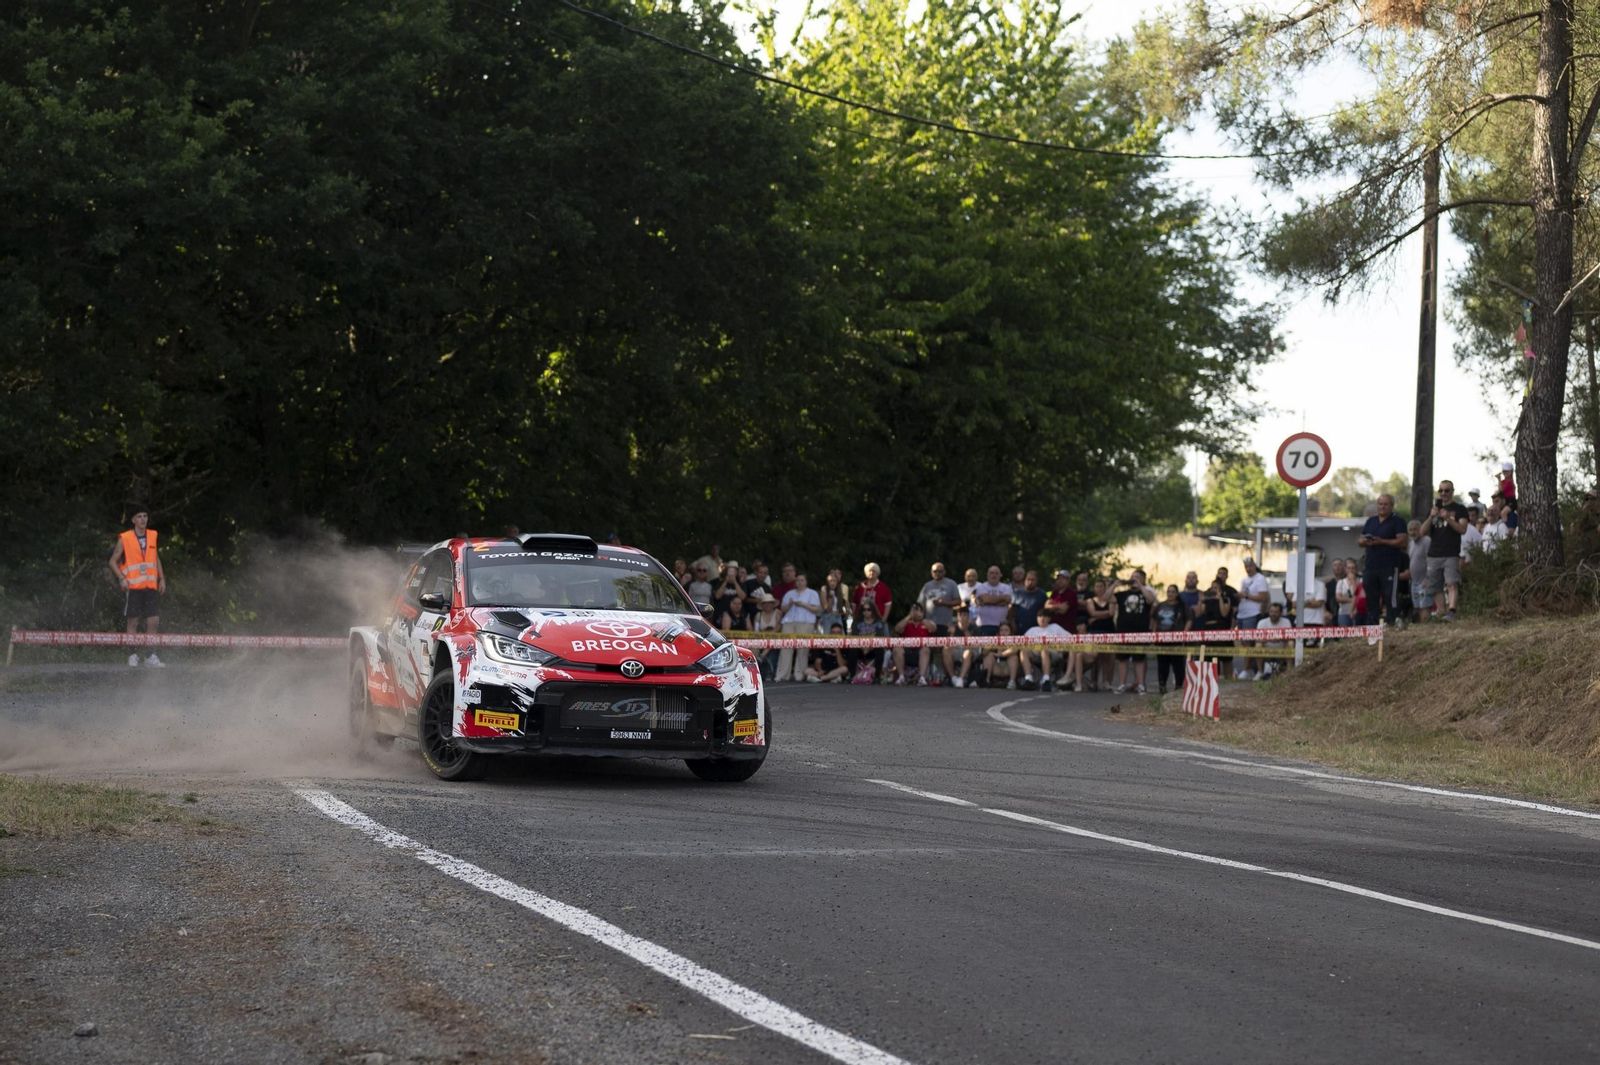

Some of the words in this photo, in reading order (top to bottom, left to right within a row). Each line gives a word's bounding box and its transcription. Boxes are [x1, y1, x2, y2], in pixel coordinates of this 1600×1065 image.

[1288, 450, 1319, 469] 70
[478, 552, 537, 560] TOYOTA
[540, 551, 594, 560] GAZOO
[597, 555, 649, 567] Racing
[738, 639, 767, 649] PROHIBIDO
[770, 639, 794, 649] PUBLICO
[796, 639, 811, 648] ZONA
[814, 638, 844, 648] PROHIBIDO
[846, 638, 869, 648] PUBLICO
[872, 638, 888, 648] ZONA
[890, 638, 920, 648] PROHIBIDO
[923, 638, 946, 647] PUBLICO
[950, 637, 965, 647] ZONA
[967, 637, 998, 646] PROHIBIDO
[1001, 636, 1024, 645] PUBLICO
[1028, 635, 1043, 644] ZONA
[1046, 634, 1076, 644] PROHIBIDO
[1079, 634, 1103, 643] PUBLICO
[1106, 633, 1122, 643] ZONA
[1125, 632, 1156, 642] PROHIBIDO
[1159, 632, 1183, 642] PUBLICO
[1186, 631, 1202, 641] ZONA
[1204, 630, 1235, 640] PROHIBIDO
[1238, 630, 1263, 640] PUBLICO
[1266, 629, 1282, 639] ZONA
[1285, 628, 1317, 639] PROHIBIDO
[1319, 627, 1344, 638] PUBLICO
[1348, 627, 1363, 637] ZONA
[571, 640, 678, 656] BREOGAN
[569, 701, 611, 711] ARES
[478, 713, 515, 727] PIRELLI
